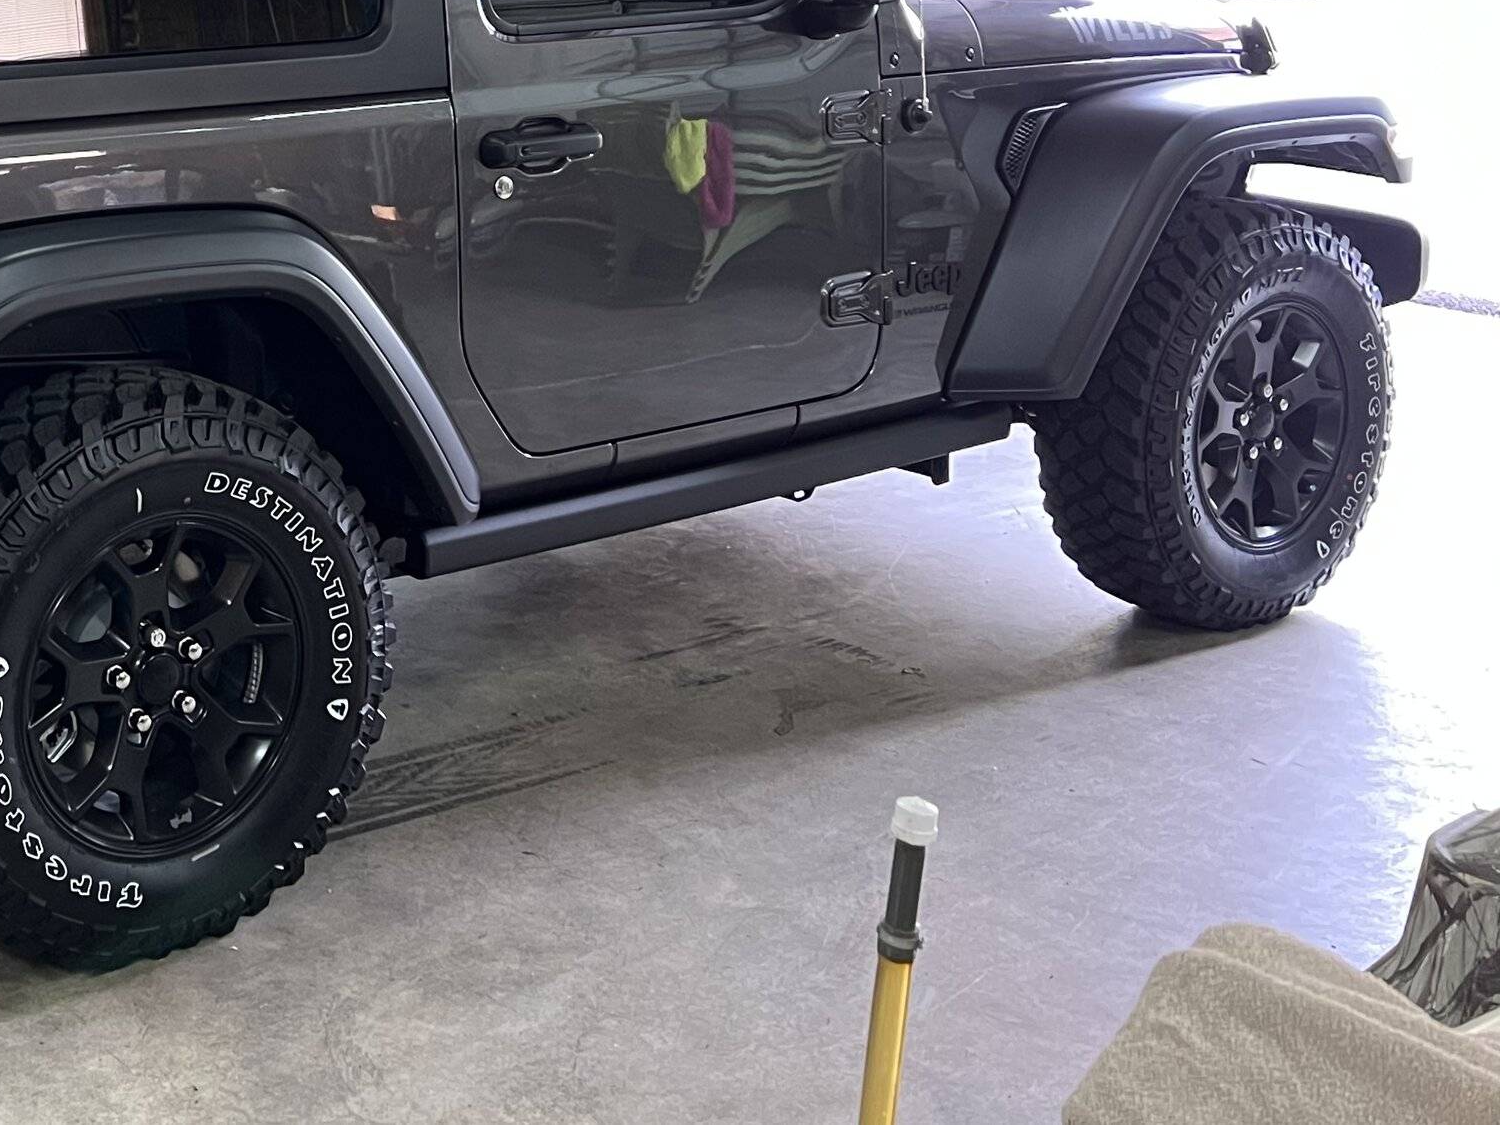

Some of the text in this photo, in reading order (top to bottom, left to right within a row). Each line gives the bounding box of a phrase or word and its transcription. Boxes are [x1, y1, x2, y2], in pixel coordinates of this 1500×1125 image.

[896, 261, 961, 297] Jeep
[1329, 332, 1382, 540] Firestone
[204, 472, 352, 685] DESTINATION
